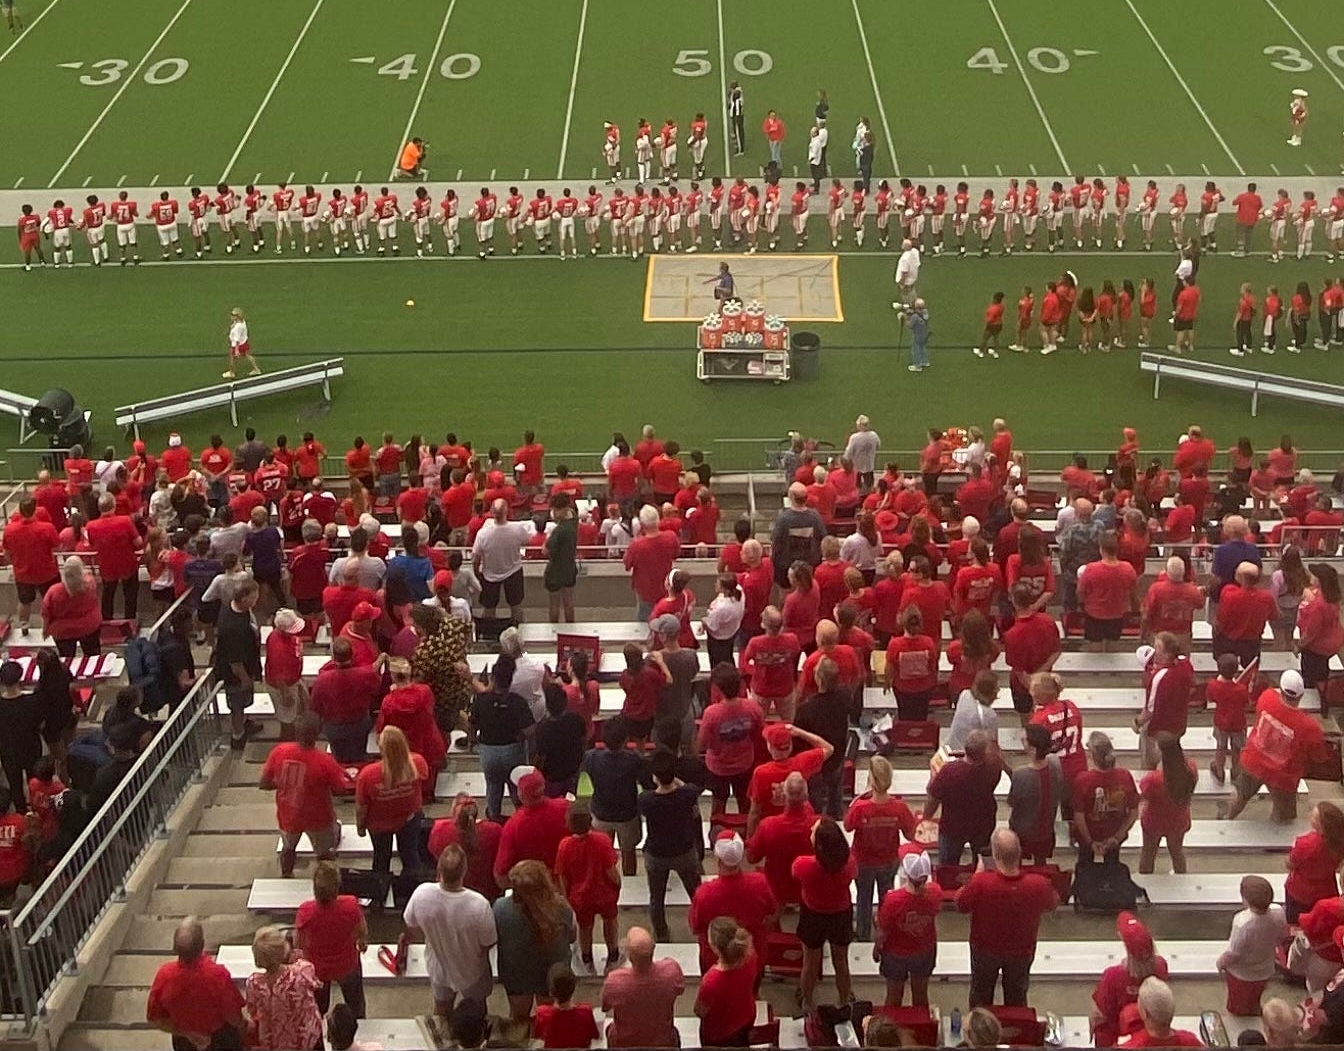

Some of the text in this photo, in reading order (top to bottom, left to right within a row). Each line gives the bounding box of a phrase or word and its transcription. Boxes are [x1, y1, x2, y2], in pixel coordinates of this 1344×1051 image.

[80, 56, 190, 87] 30
[377, 52, 483, 80] 40
[671, 48, 774, 77] 50
[966, 46, 1072, 75] 40
[263, 477, 282, 492] 27
